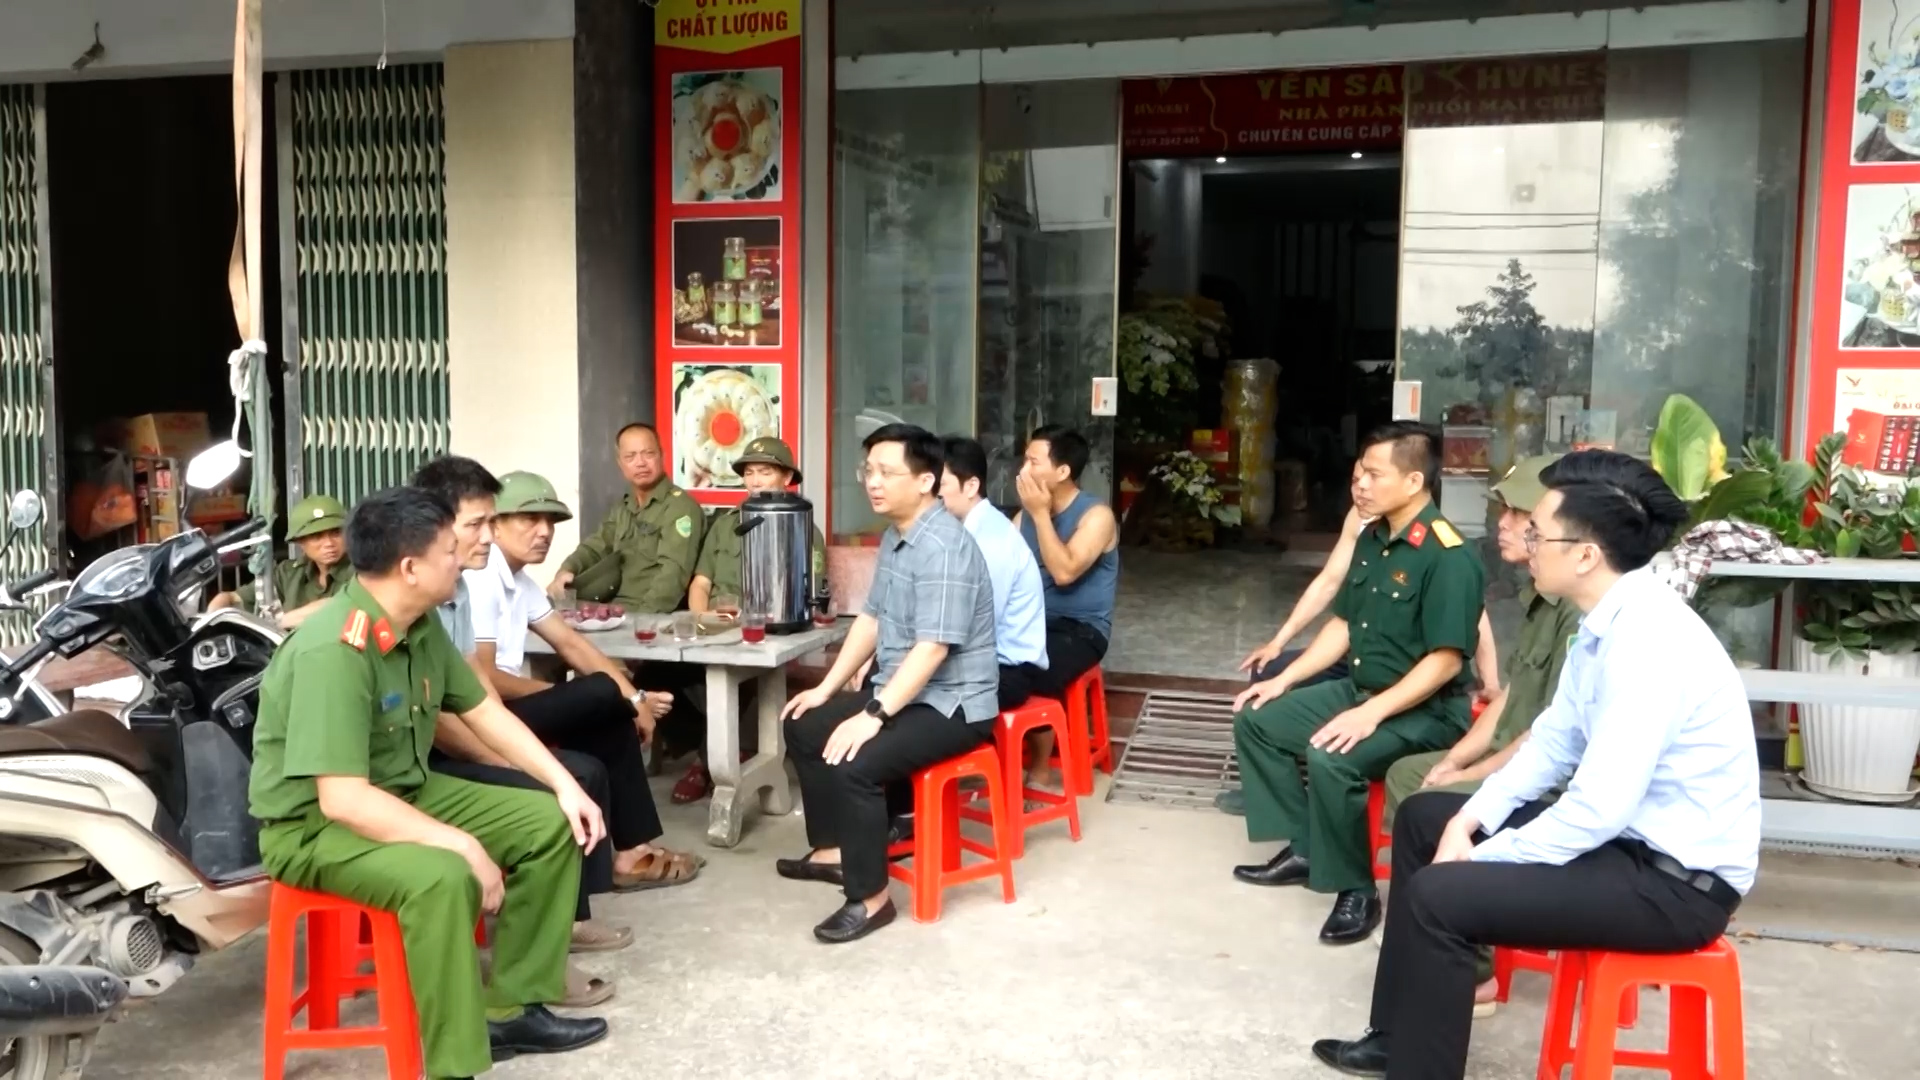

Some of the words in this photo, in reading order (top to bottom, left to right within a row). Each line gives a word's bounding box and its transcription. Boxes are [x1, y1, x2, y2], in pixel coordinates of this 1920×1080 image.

[667, 9, 717, 39] CHẤT
[722, 10, 788, 38] LƯỢNG
[1477, 62, 1638, 91] HVNES
[1279, 103, 1329, 120] NHÀ
[1238, 126, 1303, 143] CHUYÊN
[1308, 125, 1354, 141] CUNG
